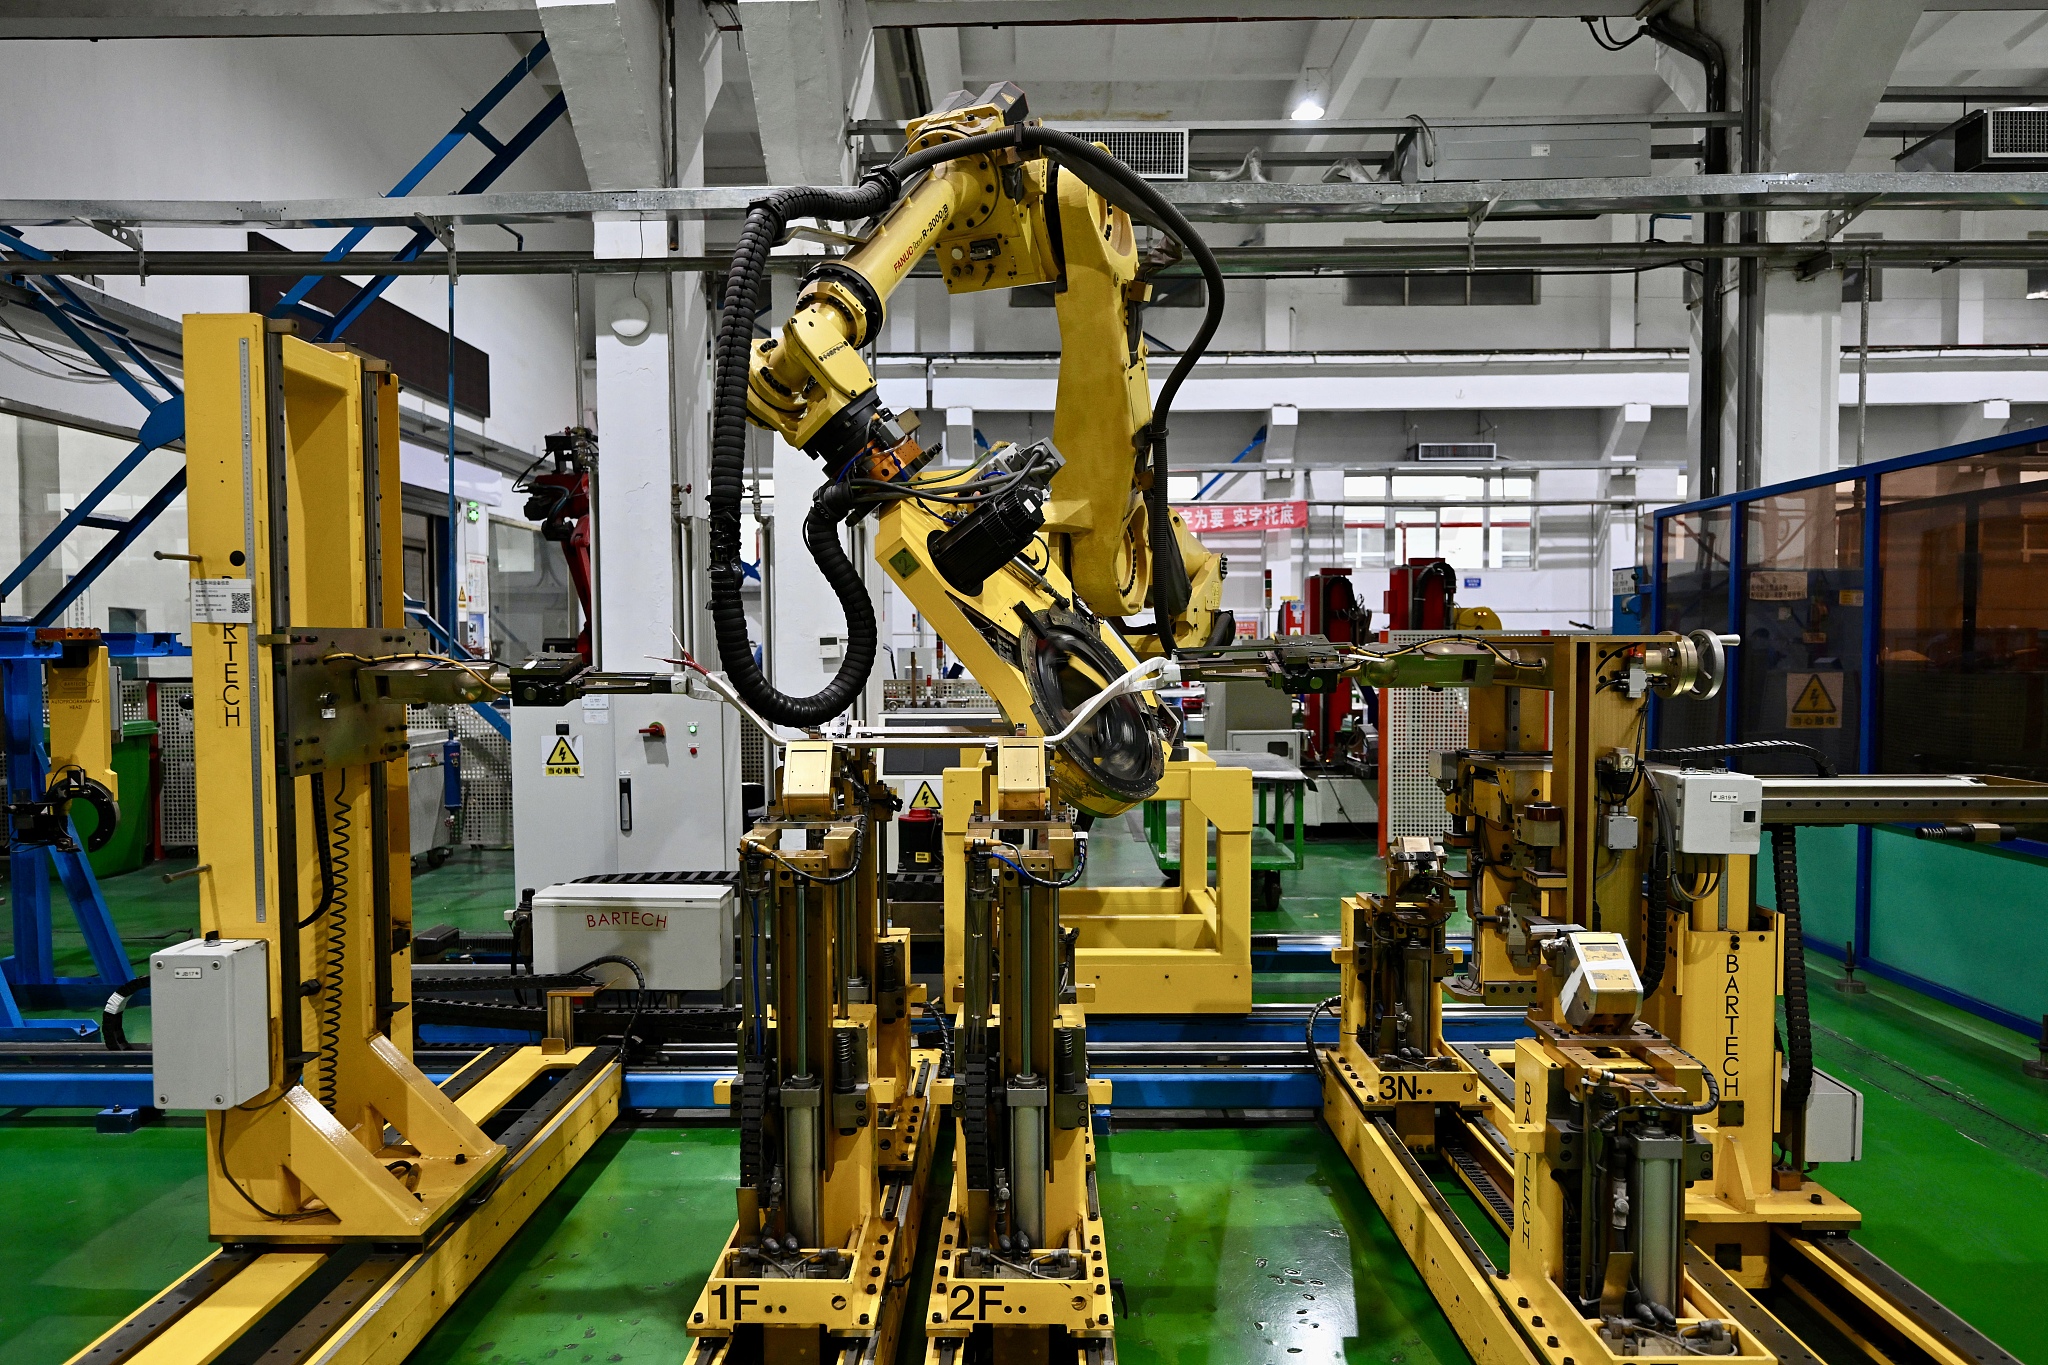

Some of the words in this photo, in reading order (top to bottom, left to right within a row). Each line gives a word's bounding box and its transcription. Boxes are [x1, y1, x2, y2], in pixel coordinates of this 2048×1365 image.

[893, 246, 914, 273] FANUC
[1233, 504, 1295, 528] 实字托底
[548, 767, 579, 775] 当心触电
[586, 911, 667, 929] BARTECH
[1722, 954, 1740, 1097] BARTECH
[1379, 1075, 1417, 1101] 3N
[1522, 1081, 1531, 1249] BATECH
[711, 1284, 760, 1321] 1F
[949, 1285, 1004, 1321] 2F
